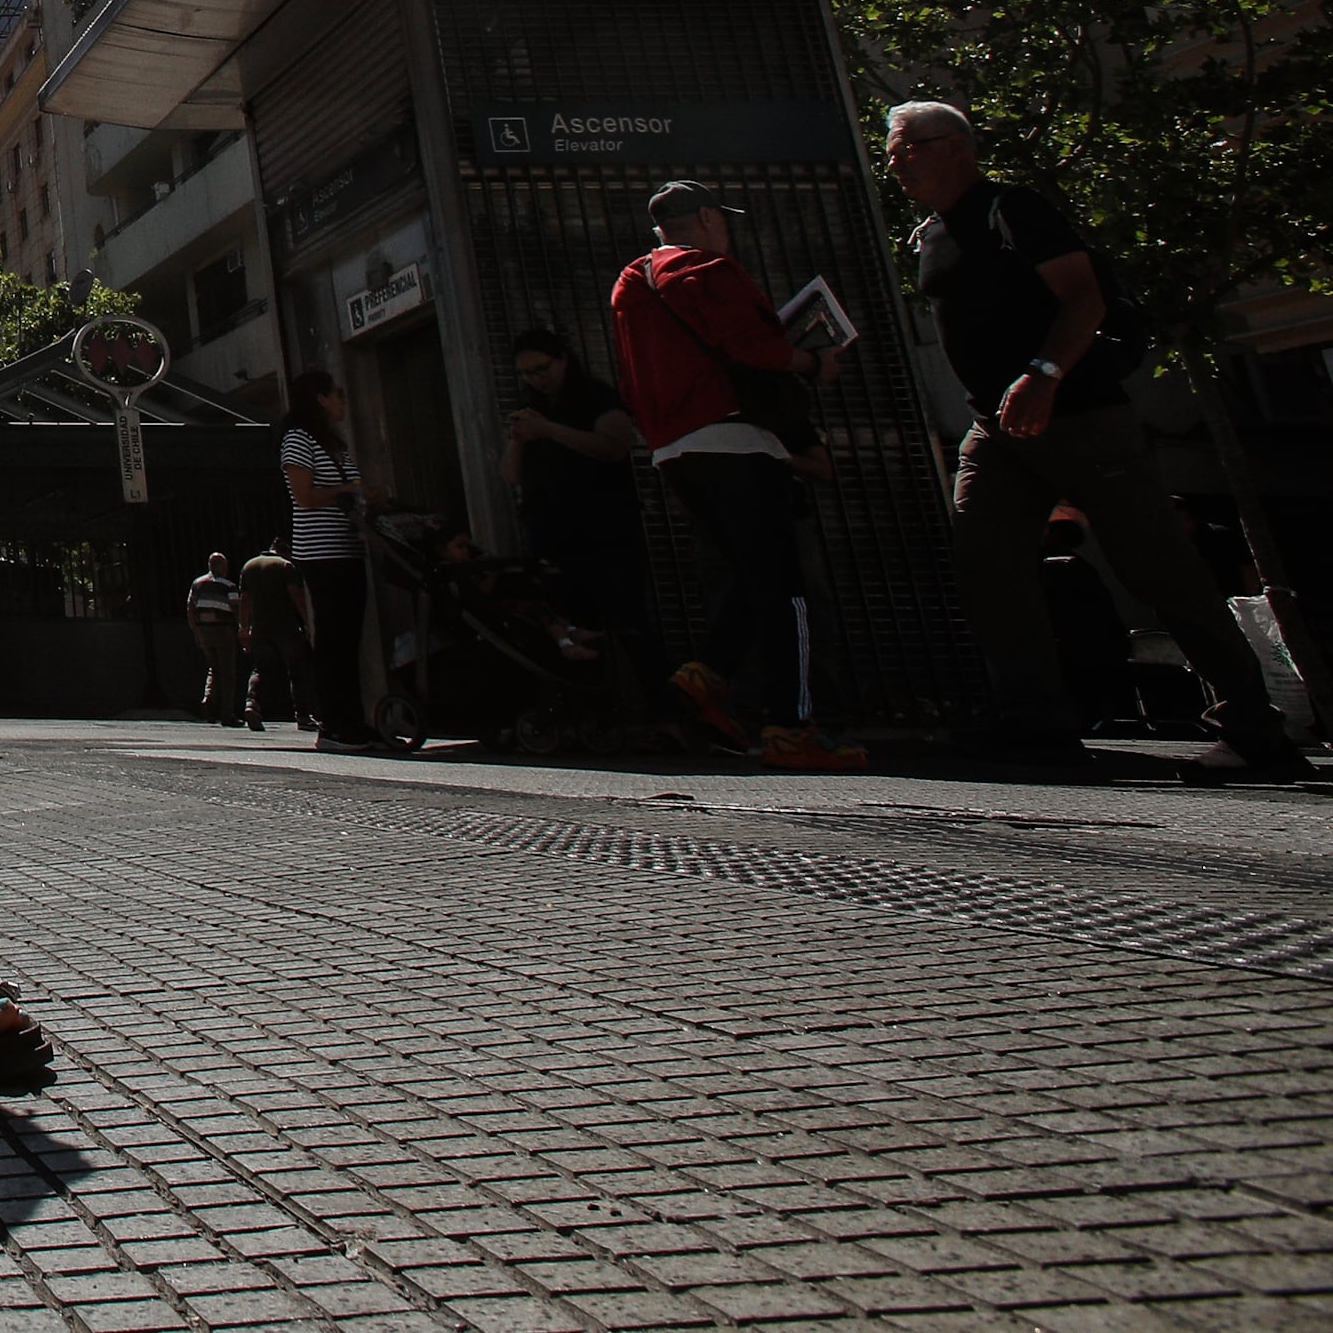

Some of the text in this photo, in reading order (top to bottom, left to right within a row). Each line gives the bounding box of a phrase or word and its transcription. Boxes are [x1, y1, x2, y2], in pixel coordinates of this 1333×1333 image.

[551, 113, 672, 134] Ascensor
[554, 138, 624, 152] Elevator
[364, 270, 417, 312] PREFERENCIAL
[119, 416, 133, 481] UNIVERSIDAD
[131, 426, 142, 470] DE CHILE
